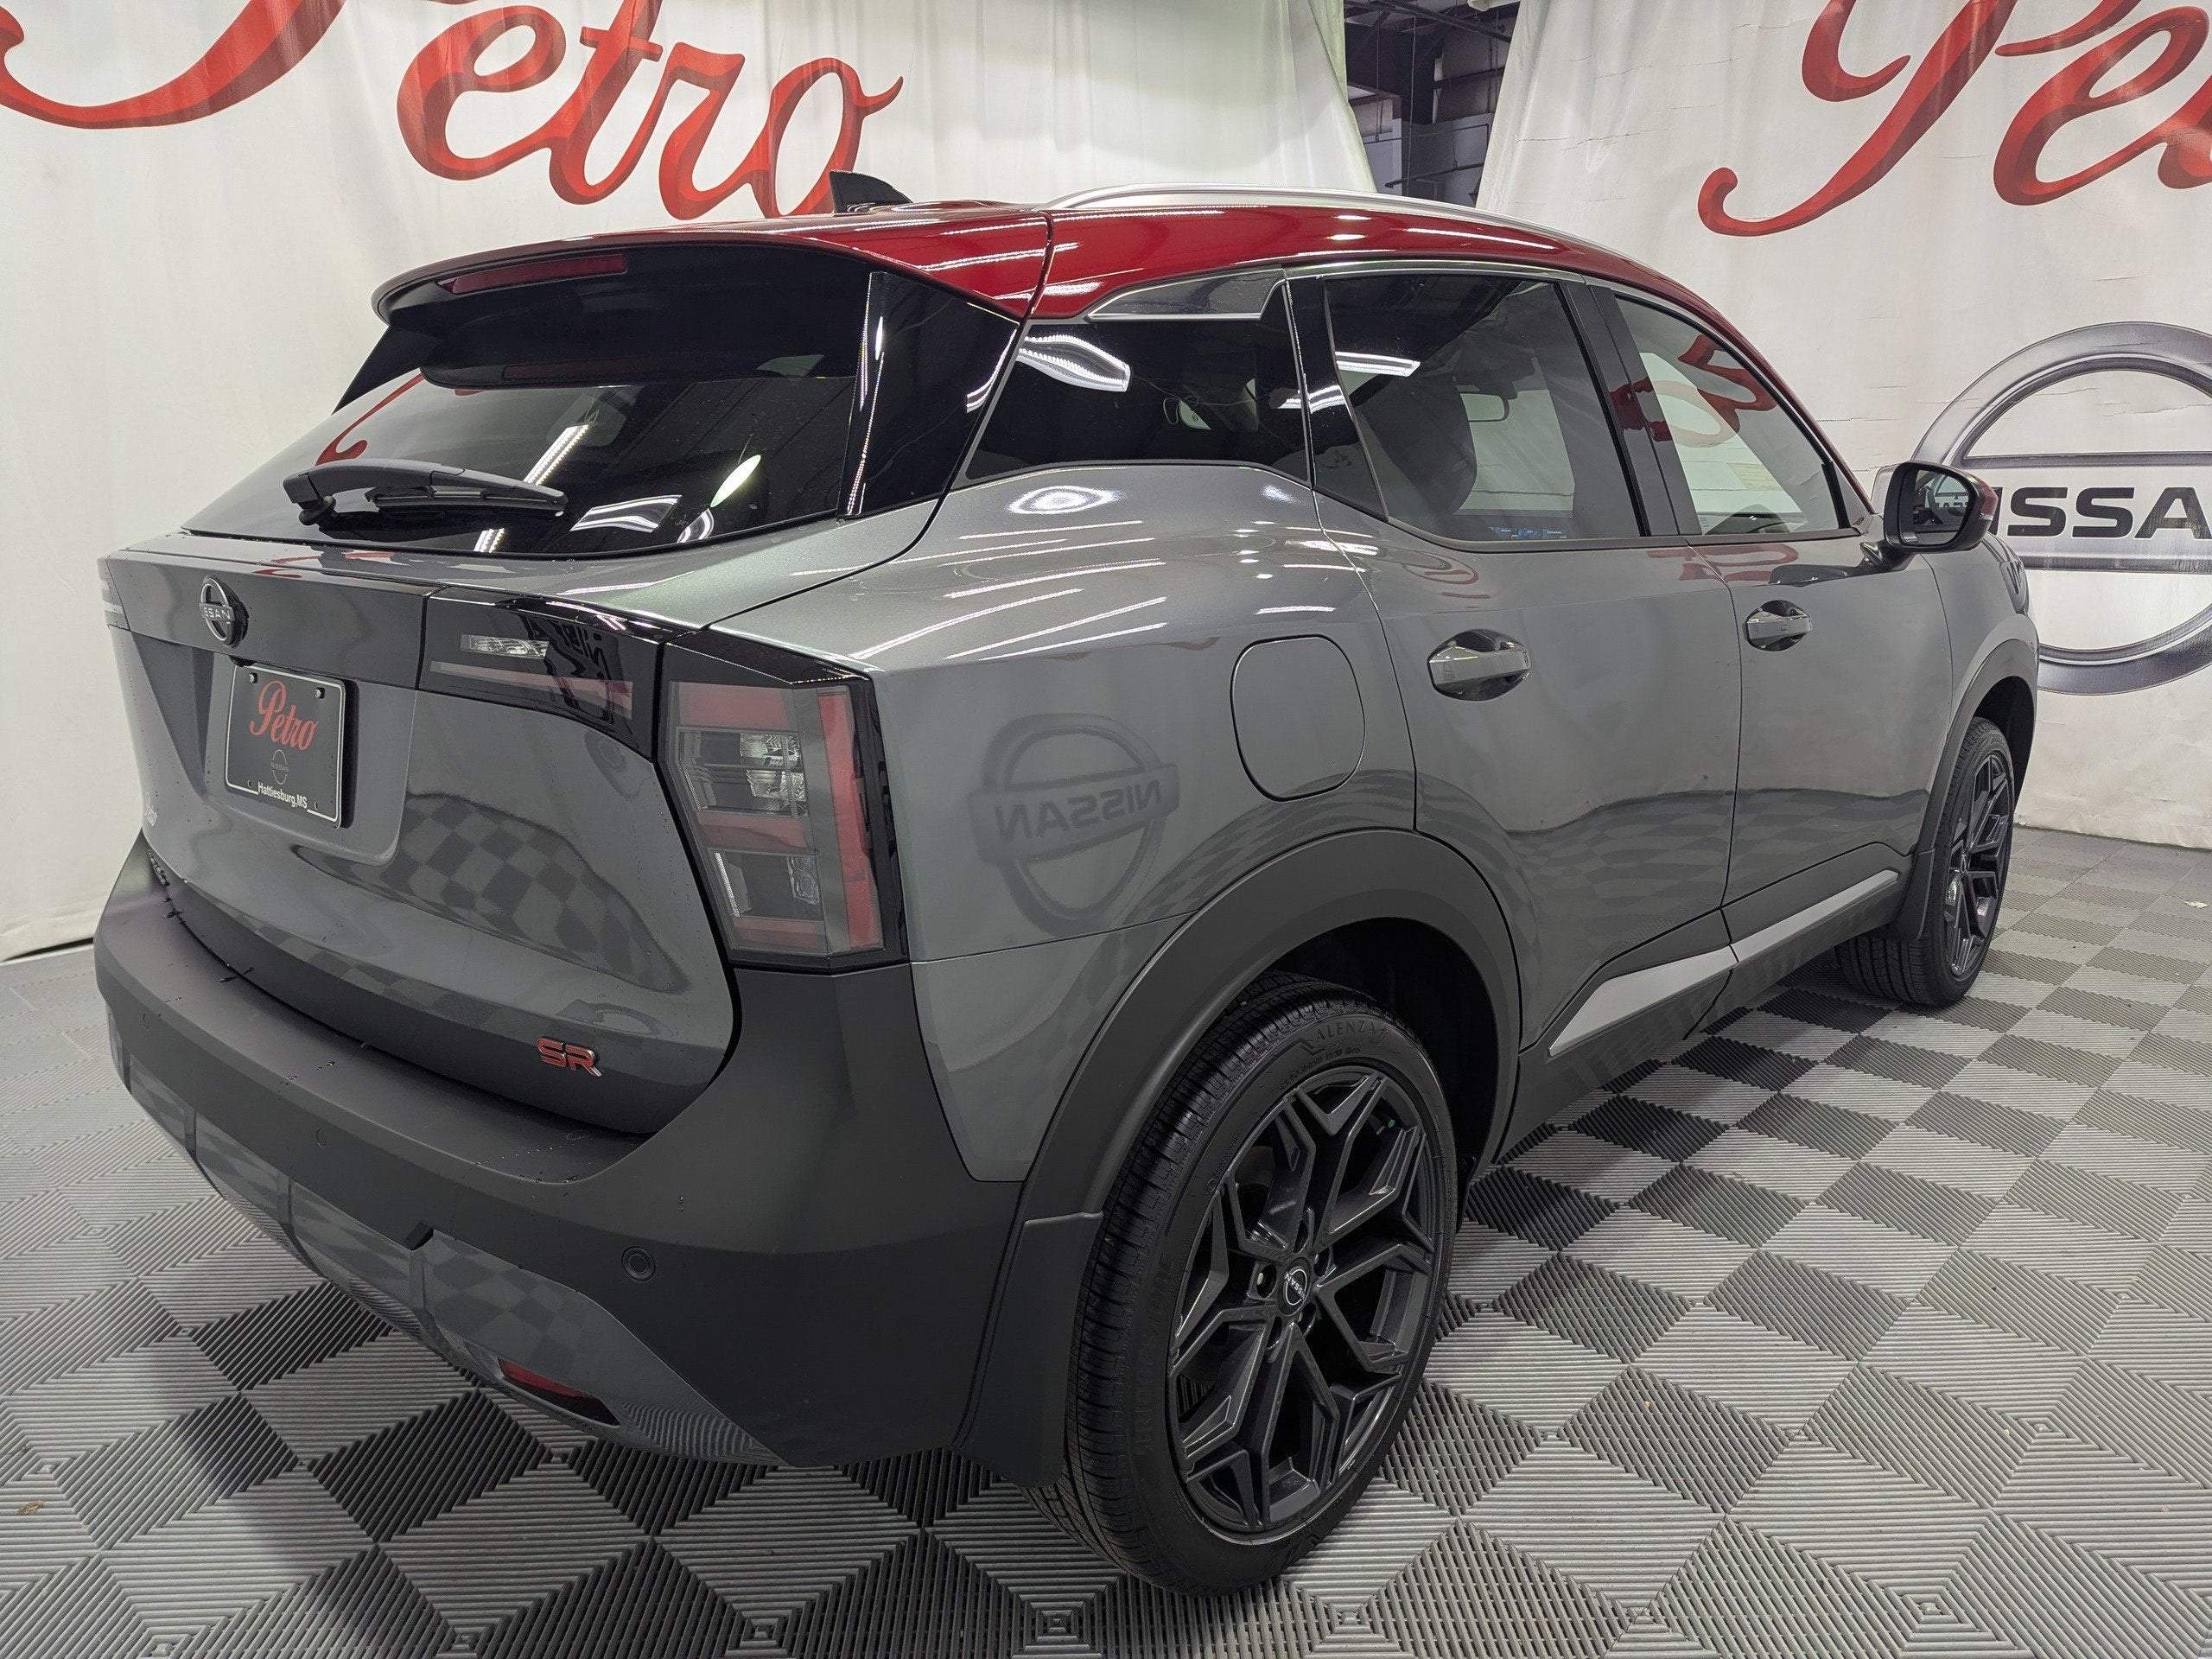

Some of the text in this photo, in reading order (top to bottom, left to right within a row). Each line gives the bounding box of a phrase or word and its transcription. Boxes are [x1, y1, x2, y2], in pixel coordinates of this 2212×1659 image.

[249, 680, 319, 751] Petro
[1316, 1020, 1376, 1042] ALENZA
[537, 1038, 602, 1077] SR
